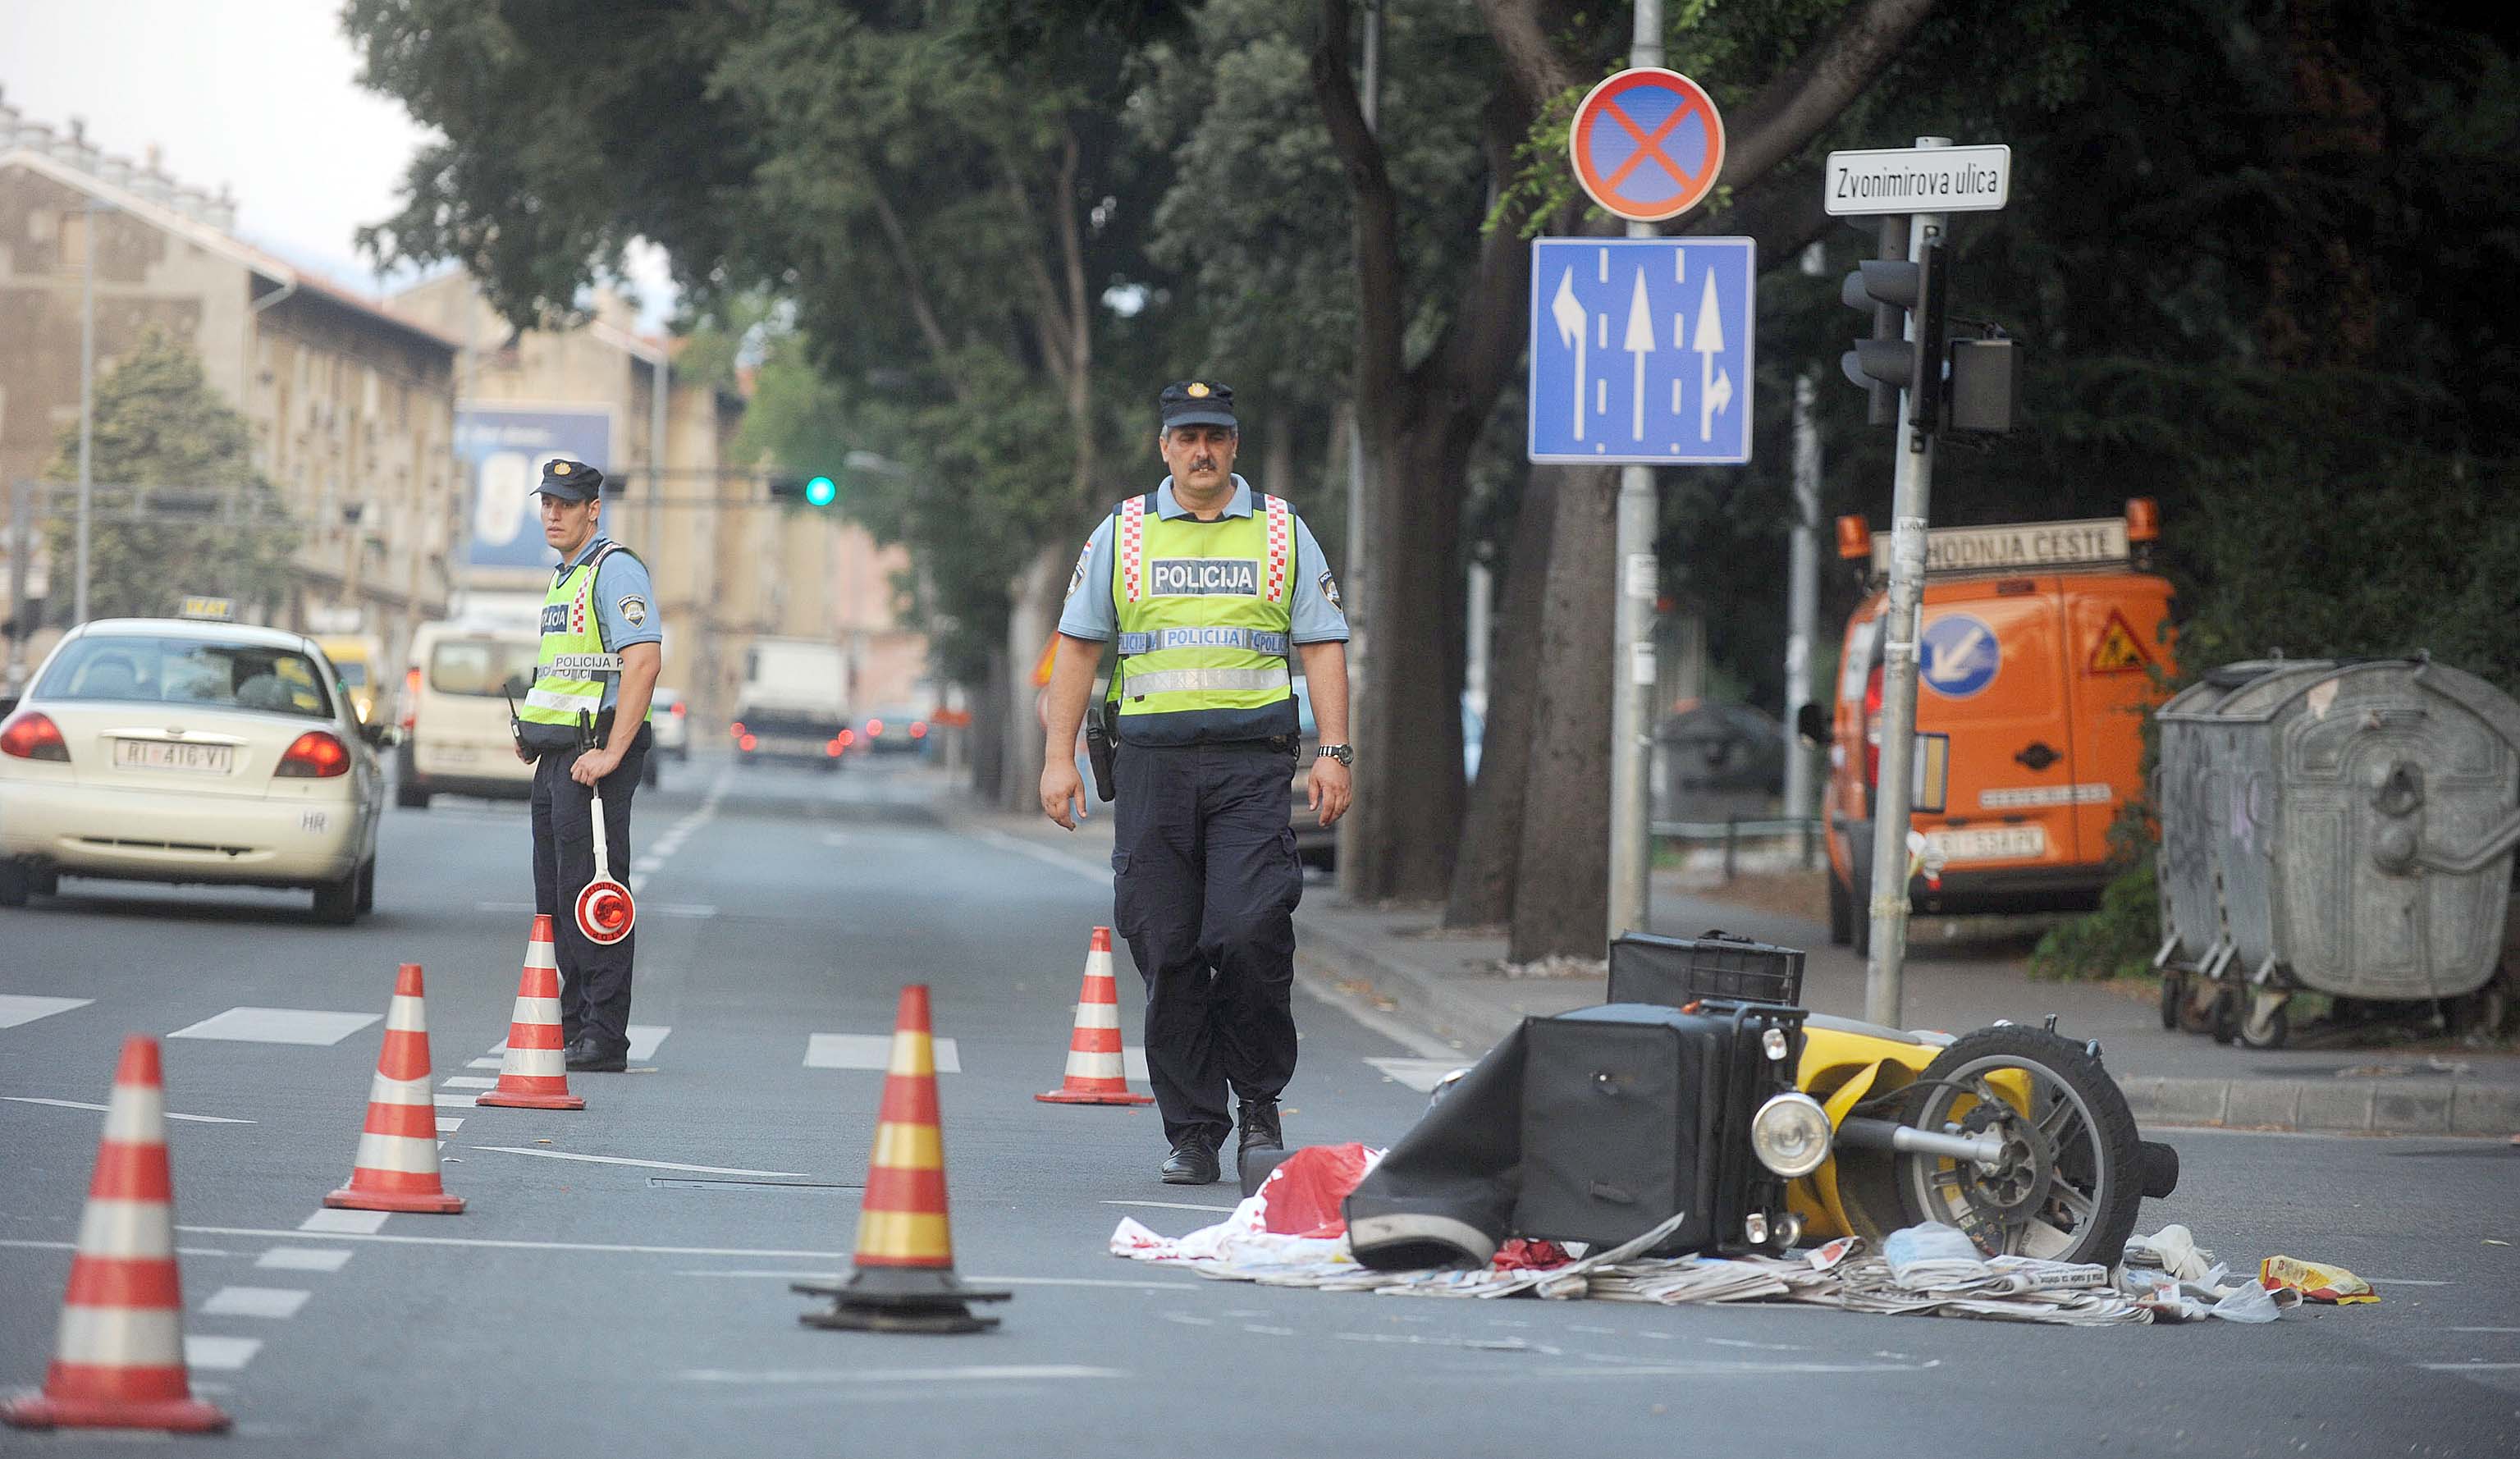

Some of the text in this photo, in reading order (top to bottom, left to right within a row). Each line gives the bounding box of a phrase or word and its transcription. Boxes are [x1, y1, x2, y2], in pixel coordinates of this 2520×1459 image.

[1837, 162, 1998, 199] Zvonimirova ulica
[1927, 534, 2026, 565] HODNJA
[1155, 565, 1253, 588] POLICIJA
[1168, 629, 1240, 646] POLICIJA
[556, 656, 611, 668] POLICIJA
[128, 742, 148, 763] RI
[303, 812, 325, 830] HR
